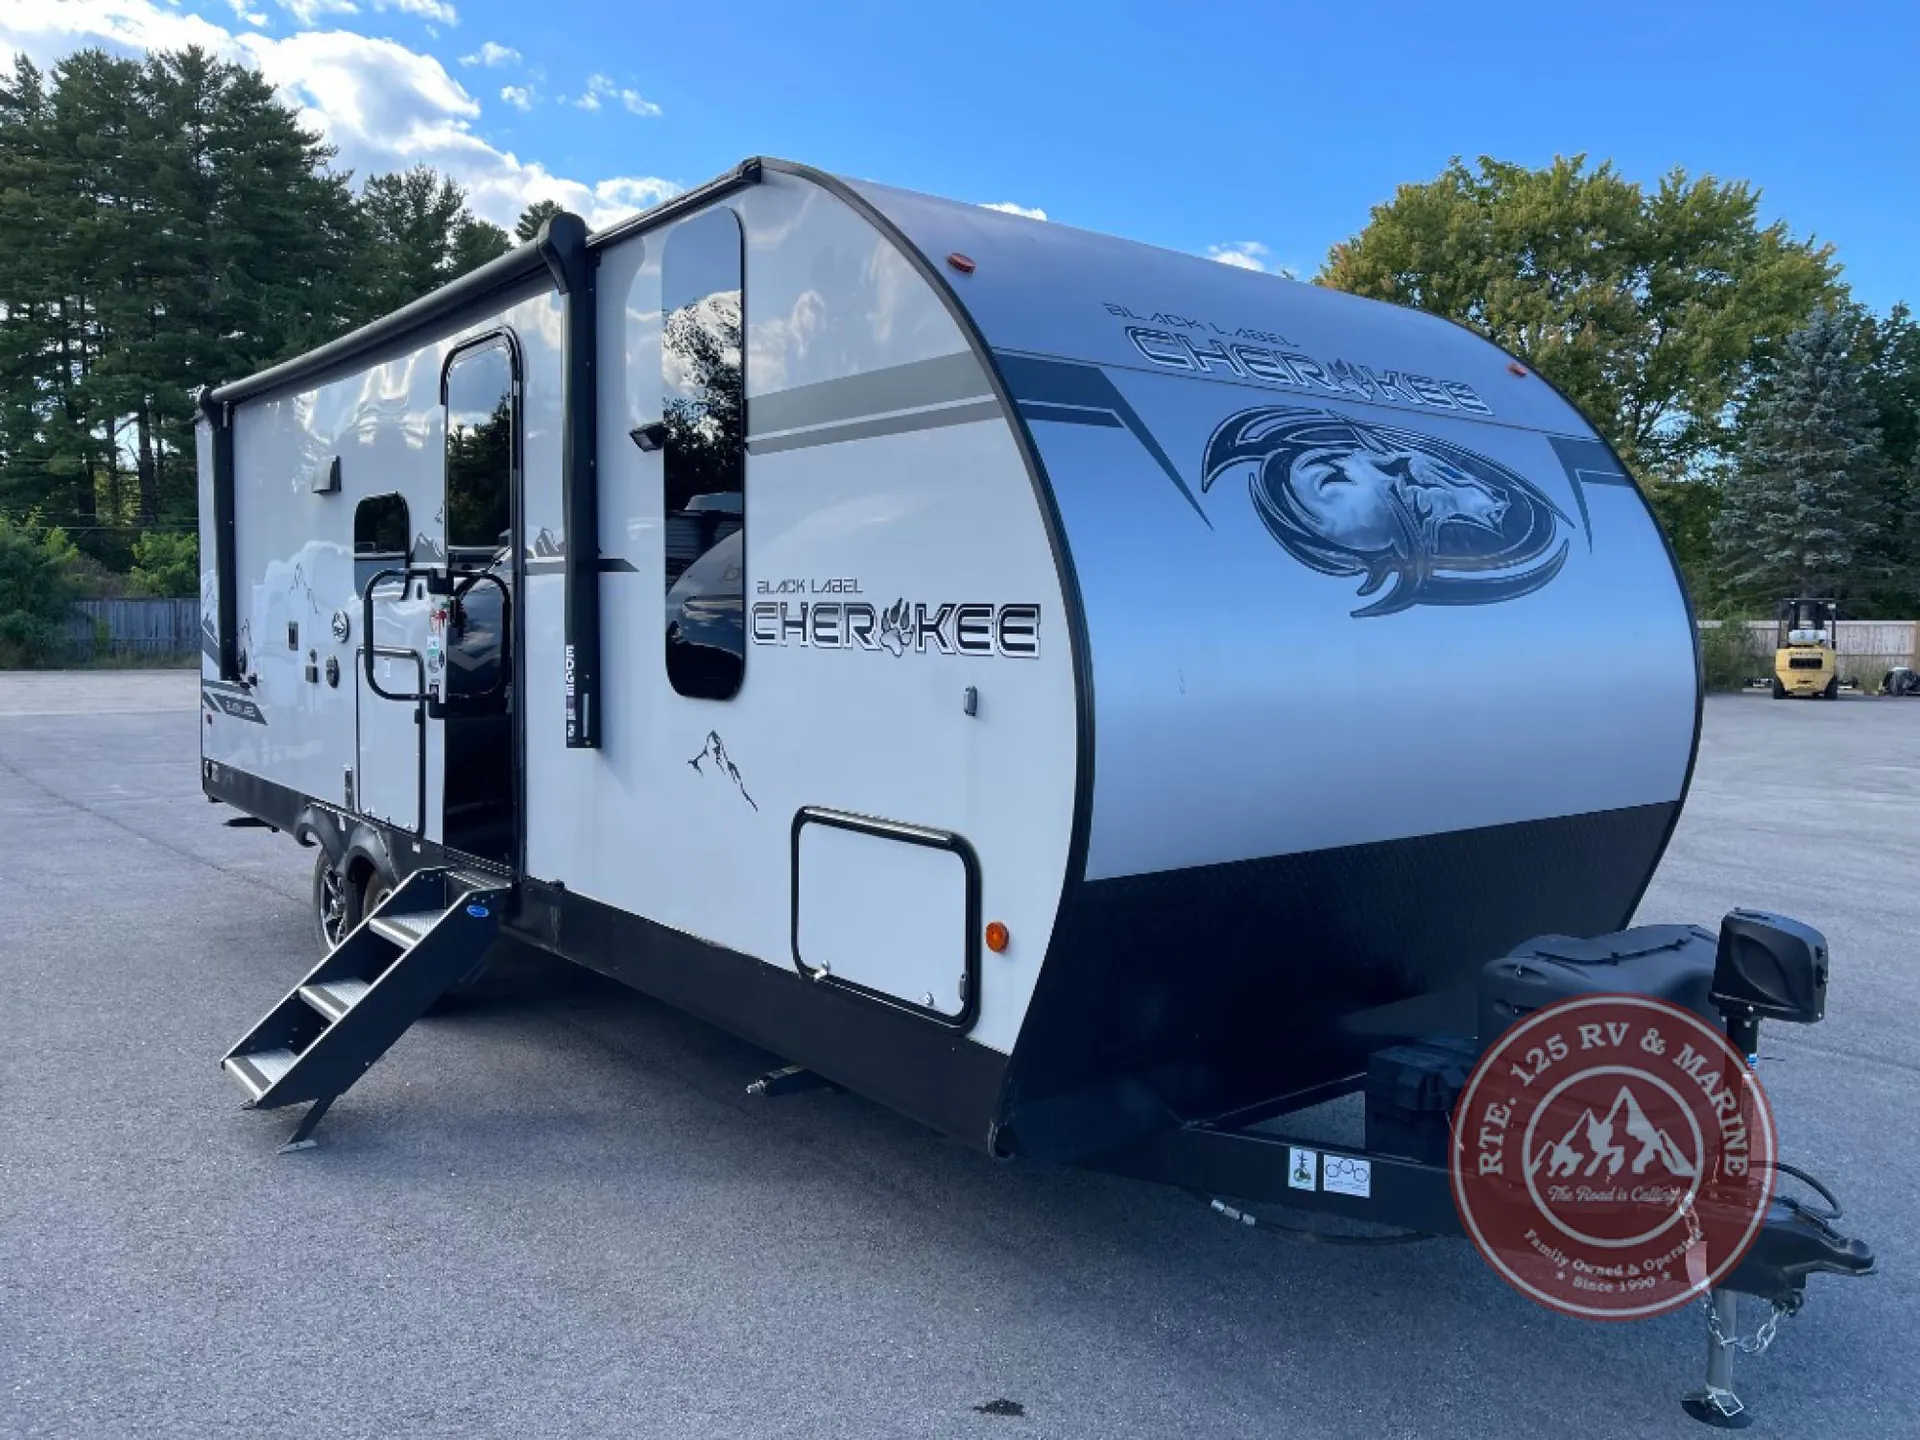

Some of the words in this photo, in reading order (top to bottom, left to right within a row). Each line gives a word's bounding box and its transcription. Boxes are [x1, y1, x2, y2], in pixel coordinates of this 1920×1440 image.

[1102, 301, 1206, 331] BLACK
[1209, 322, 1300, 348] LABEL
[756, 578, 806, 594] BLACK
[811, 577, 864, 594] LABEL
